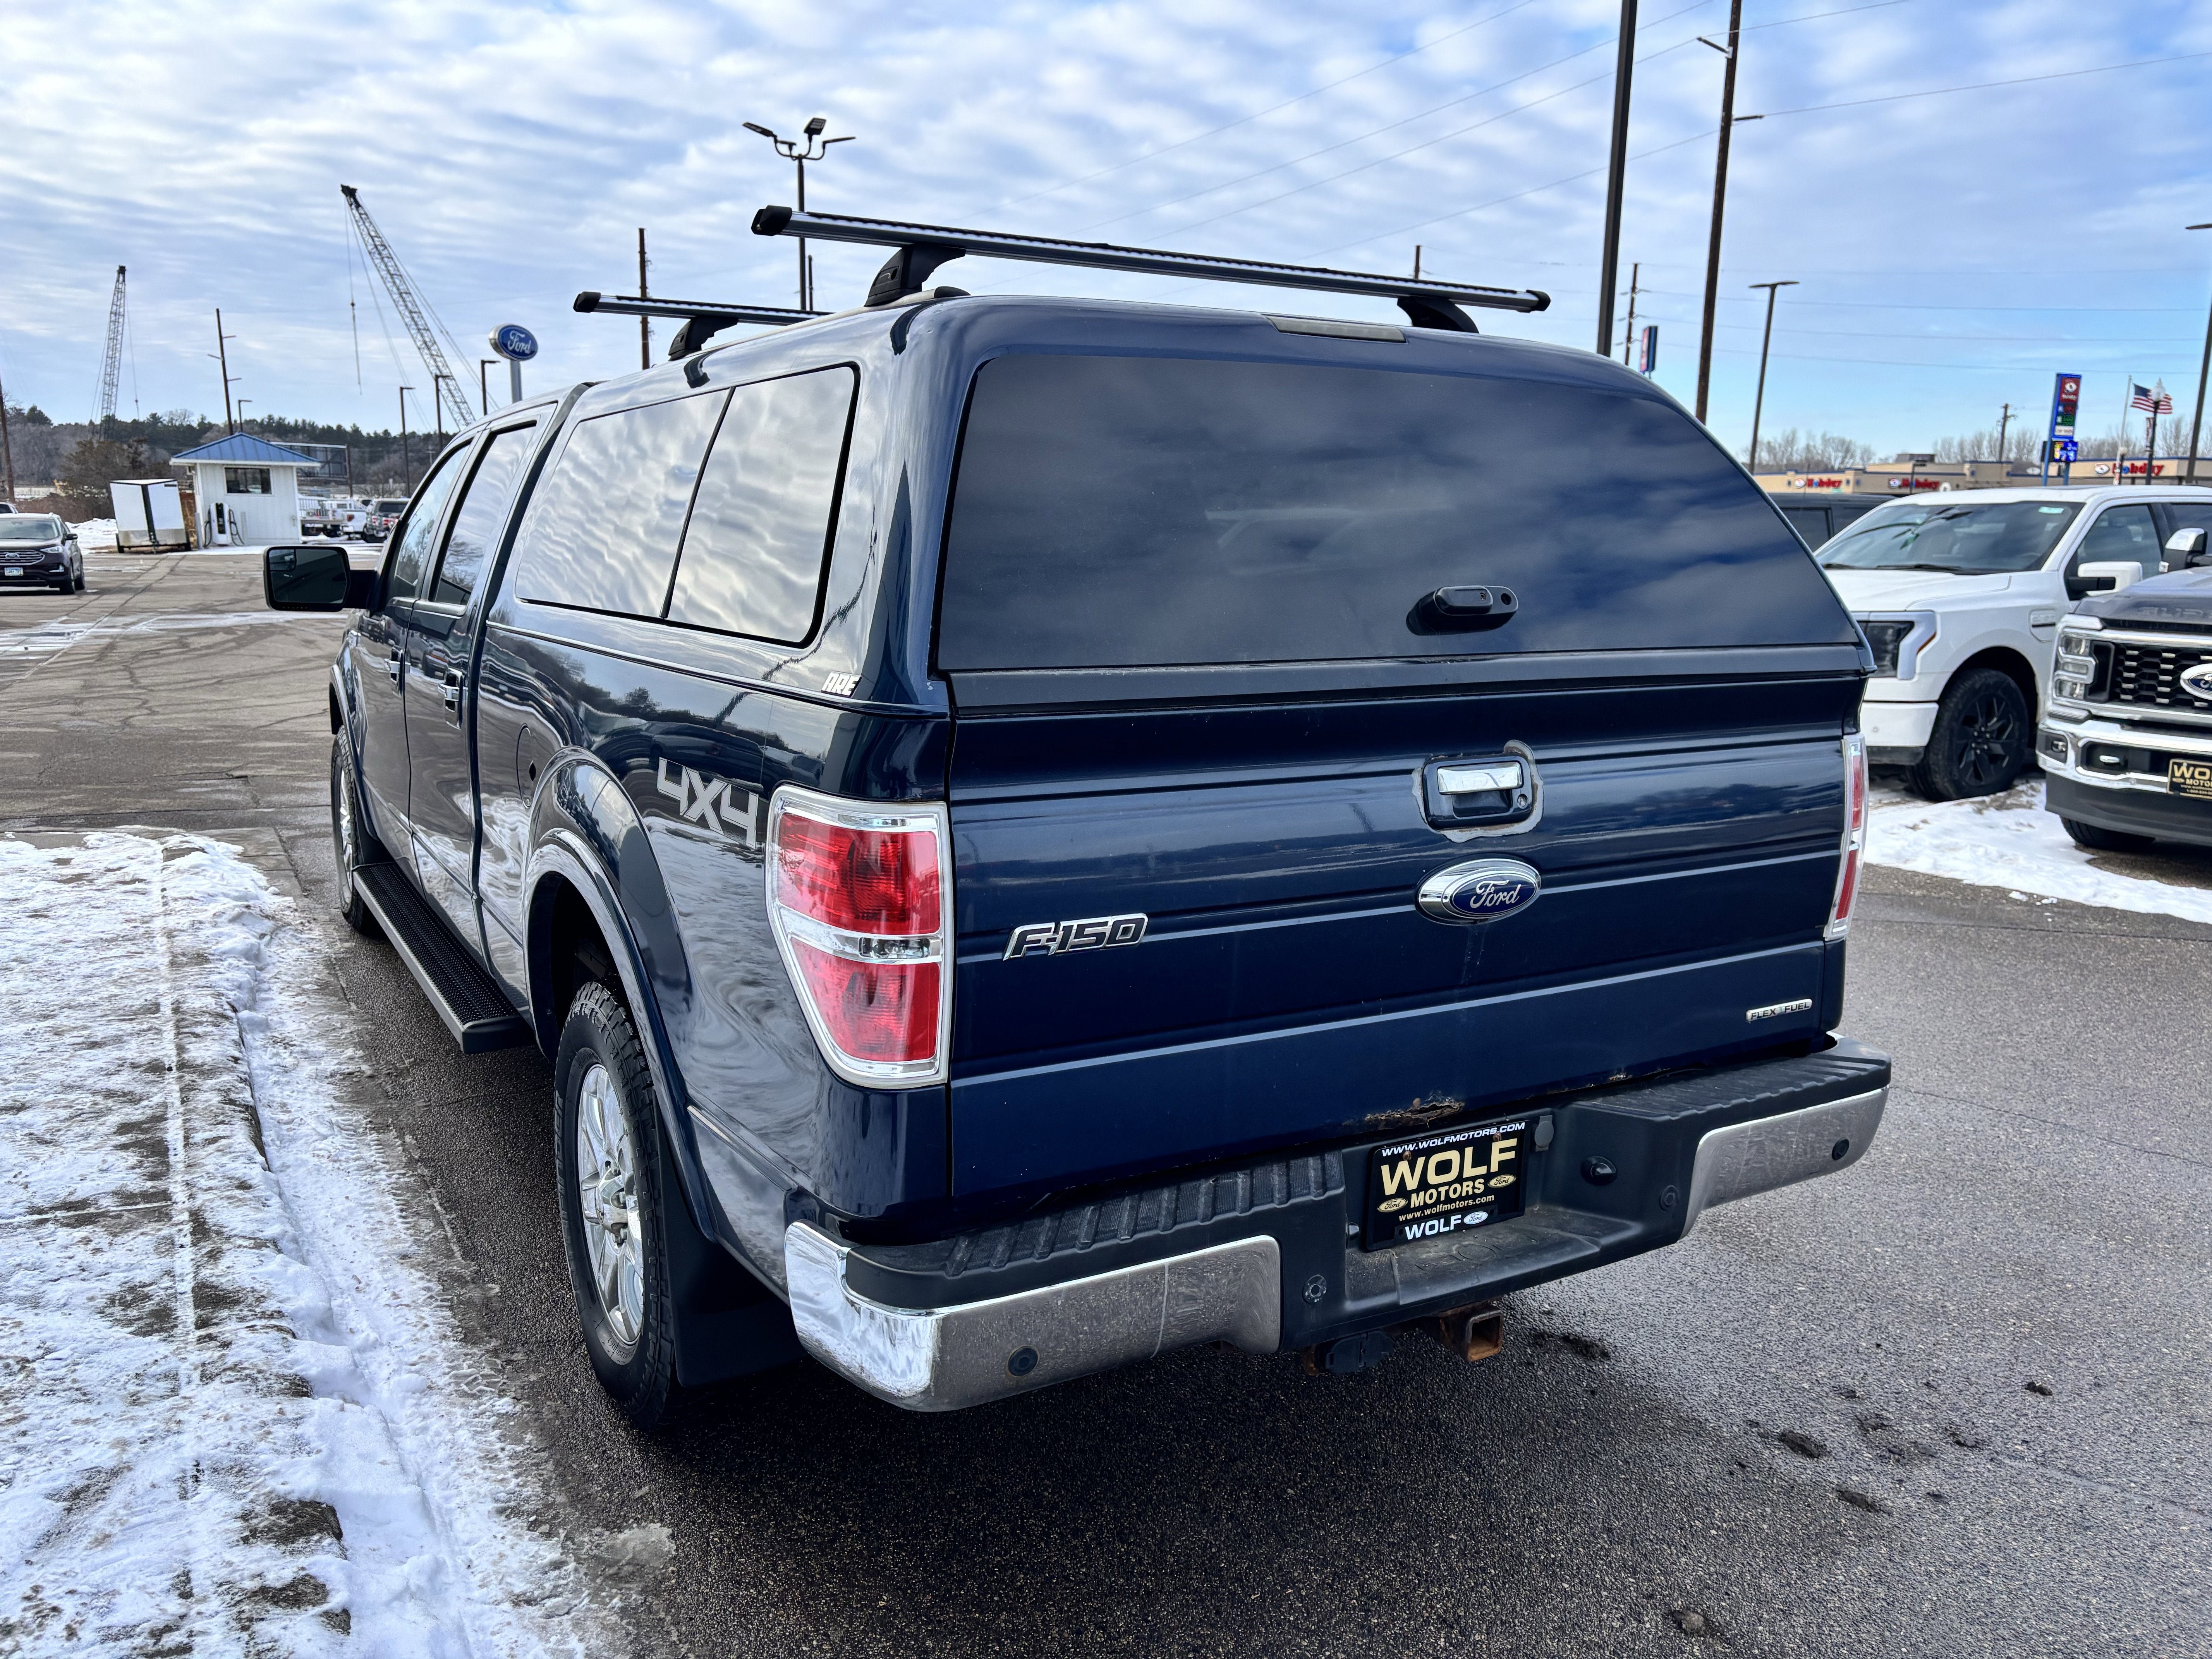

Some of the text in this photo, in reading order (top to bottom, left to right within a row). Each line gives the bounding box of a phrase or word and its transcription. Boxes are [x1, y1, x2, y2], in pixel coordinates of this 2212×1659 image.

[507, 330, 531, 354] Ford
[821, 671, 860, 696] ARE
[2173, 764, 2212, 781] WO
[2186, 778, 2212, 788] MOTO
[657, 756, 759, 849] 4X4
[1470, 879, 1522, 908] Ford
[1003, 913, 1149, 961] F-150
[1750, 1002, 1810, 1020] FLEX FUEL
[1382, 1122, 1525, 1157] WWW.WOLFMOTORS.COM
[1381, 1138, 1518, 1196] WOLF
[1410, 1178, 1485, 1209] MOTORS
[1494, 1176, 1510, 1187] Ford
[1384, 1199, 1401, 1210] Ford
[1399, 1194, 1495, 1222] www.wolfmotors.com
[1405, 1212, 1482, 1240] WOLF Ford
